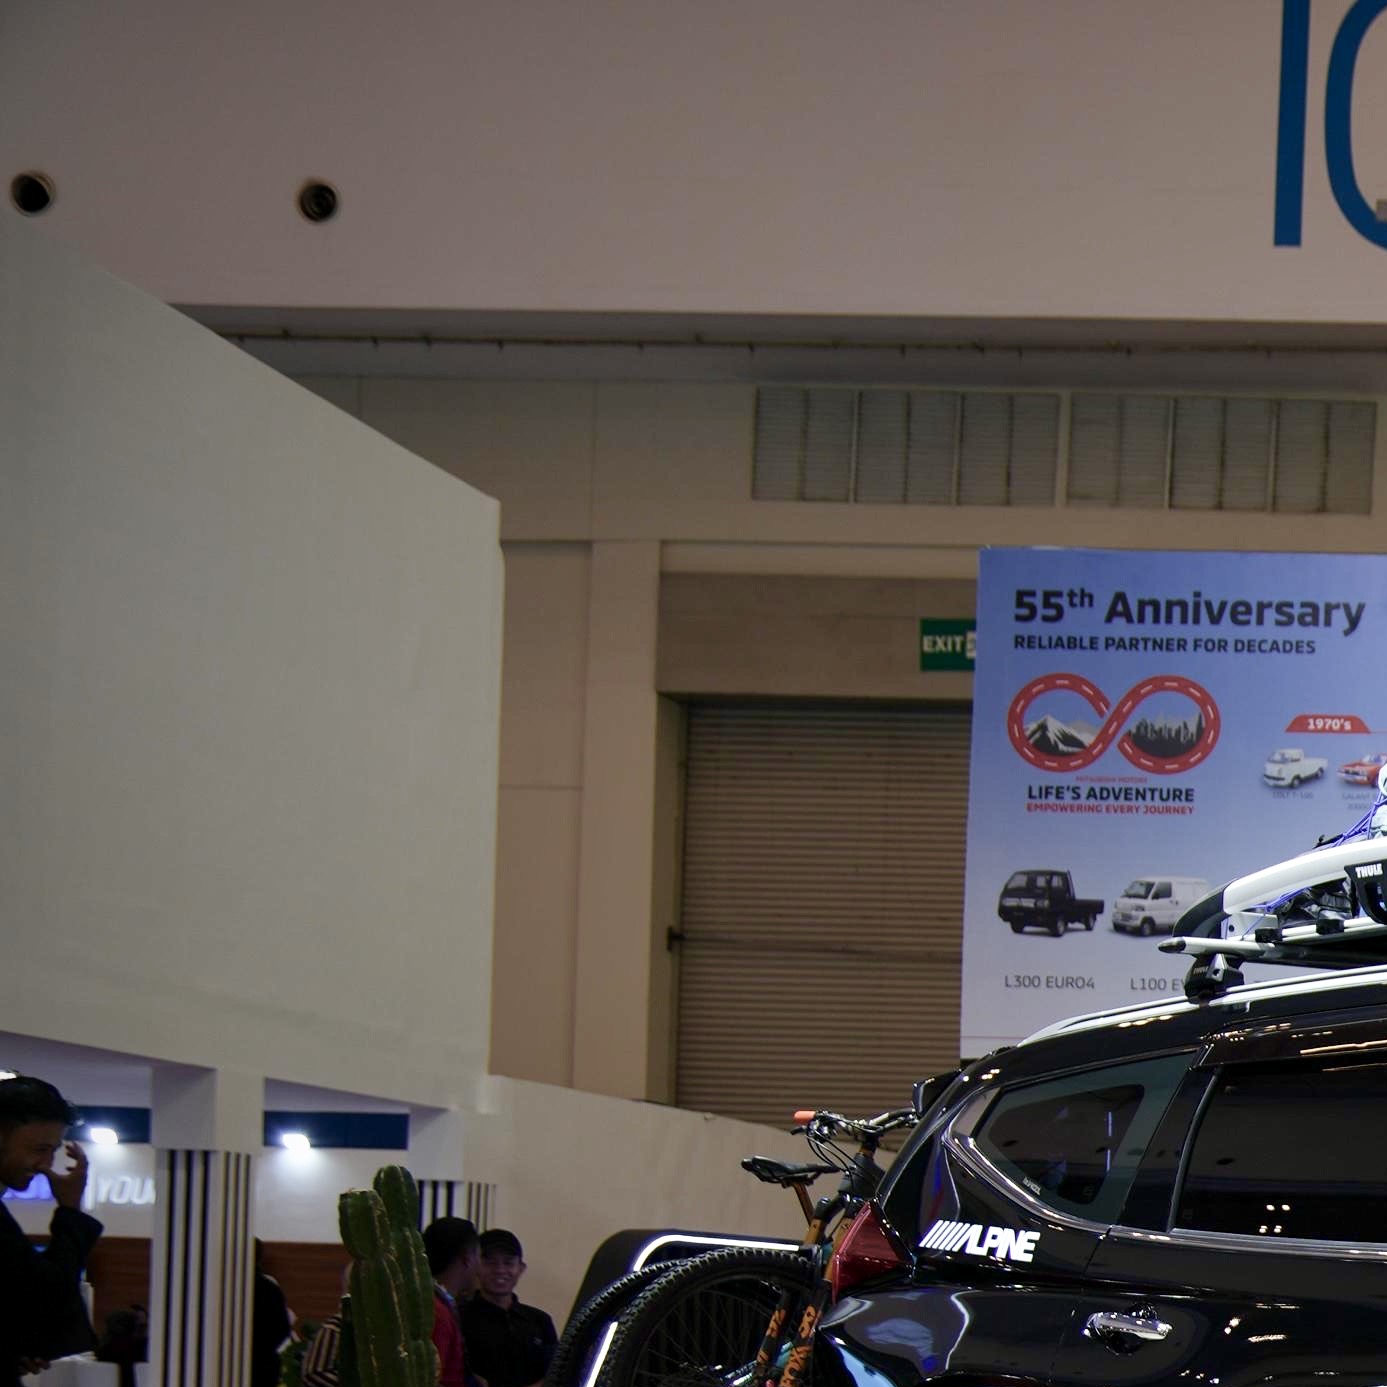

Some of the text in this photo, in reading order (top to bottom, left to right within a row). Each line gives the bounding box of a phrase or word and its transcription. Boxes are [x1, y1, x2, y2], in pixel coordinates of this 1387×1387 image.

[1014, 588, 1366, 636] 55th Anniversary
[922, 635, 964, 653] EXIT
[1014, 634, 1316, 654] RELIABLE PARTNER FOR DECADES
[1086, 786, 1195, 802] ADVENTURE
[1027, 803, 1194, 816] EMPOWERING EVERY JOURNEY
[1355, 863, 1383, 878] THULE
[1004, 975, 1095, 989] L300 EURO4
[1130, 978, 1167, 991] L100
